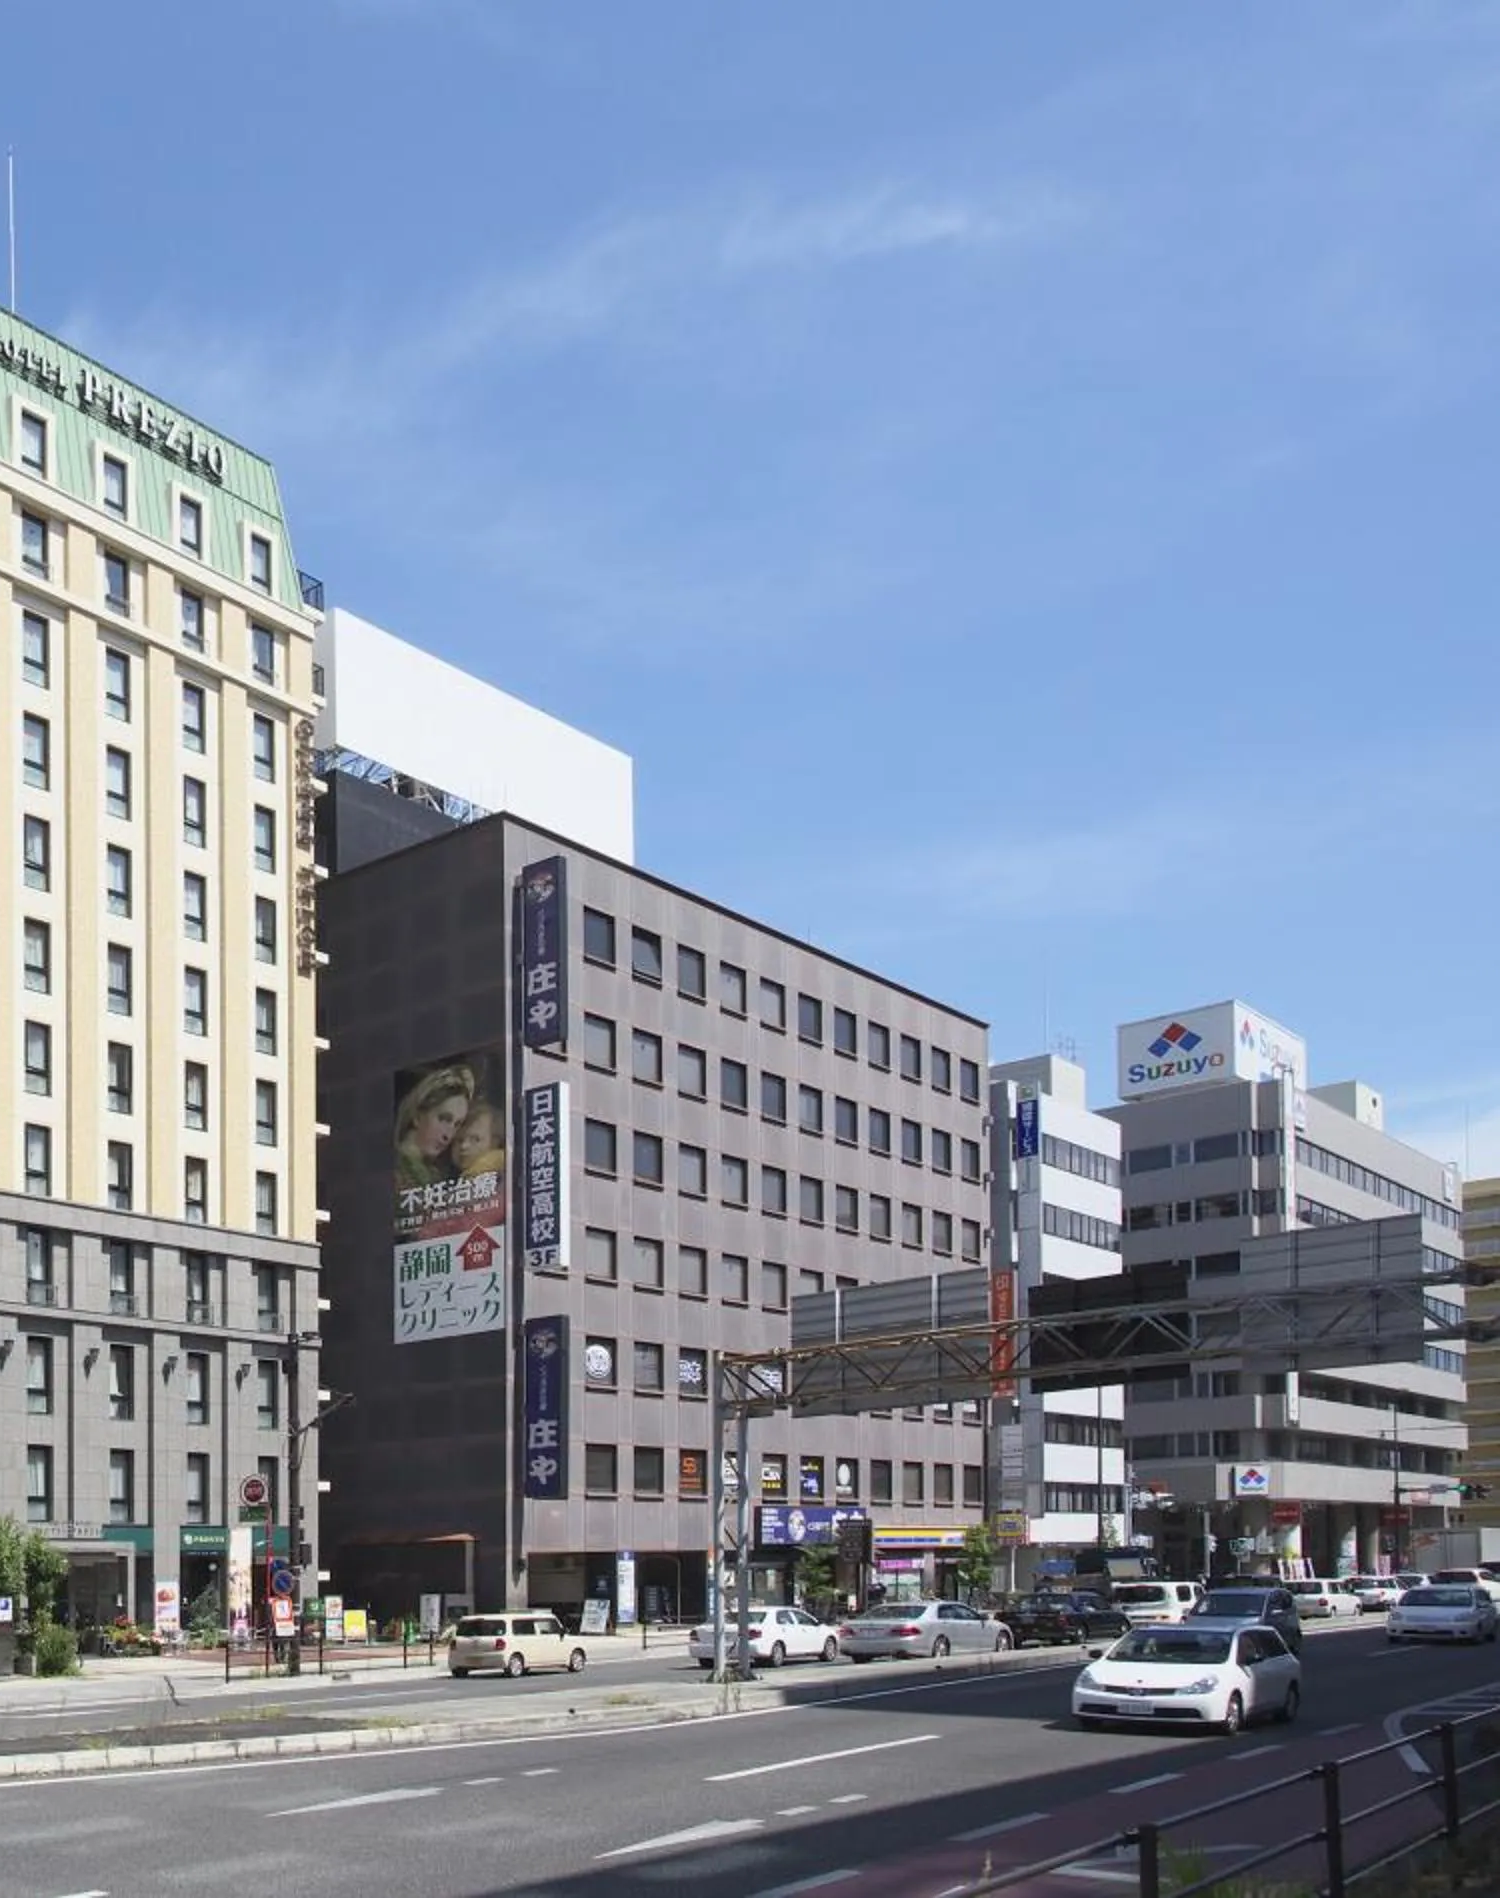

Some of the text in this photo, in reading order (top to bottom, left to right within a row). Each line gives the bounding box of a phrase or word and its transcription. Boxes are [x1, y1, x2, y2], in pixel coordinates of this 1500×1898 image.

[77, 368, 228, 480] PREZIO
[527, 961, 558, 1029] 庄や
[1128, 1052, 1225, 1084] Suzuyo
[531, 1089, 556, 1244] 日本航空高校
[400, 1171, 498, 1214] 不妊治療
[400, 1243, 451, 1283] 静岡
[531, 1249, 557, 1268] 3F
[401, 1271, 500, 1309] レディース
[401, 1299, 500, 1336] クリニック
[528, 1418, 558, 1485] 庄や
